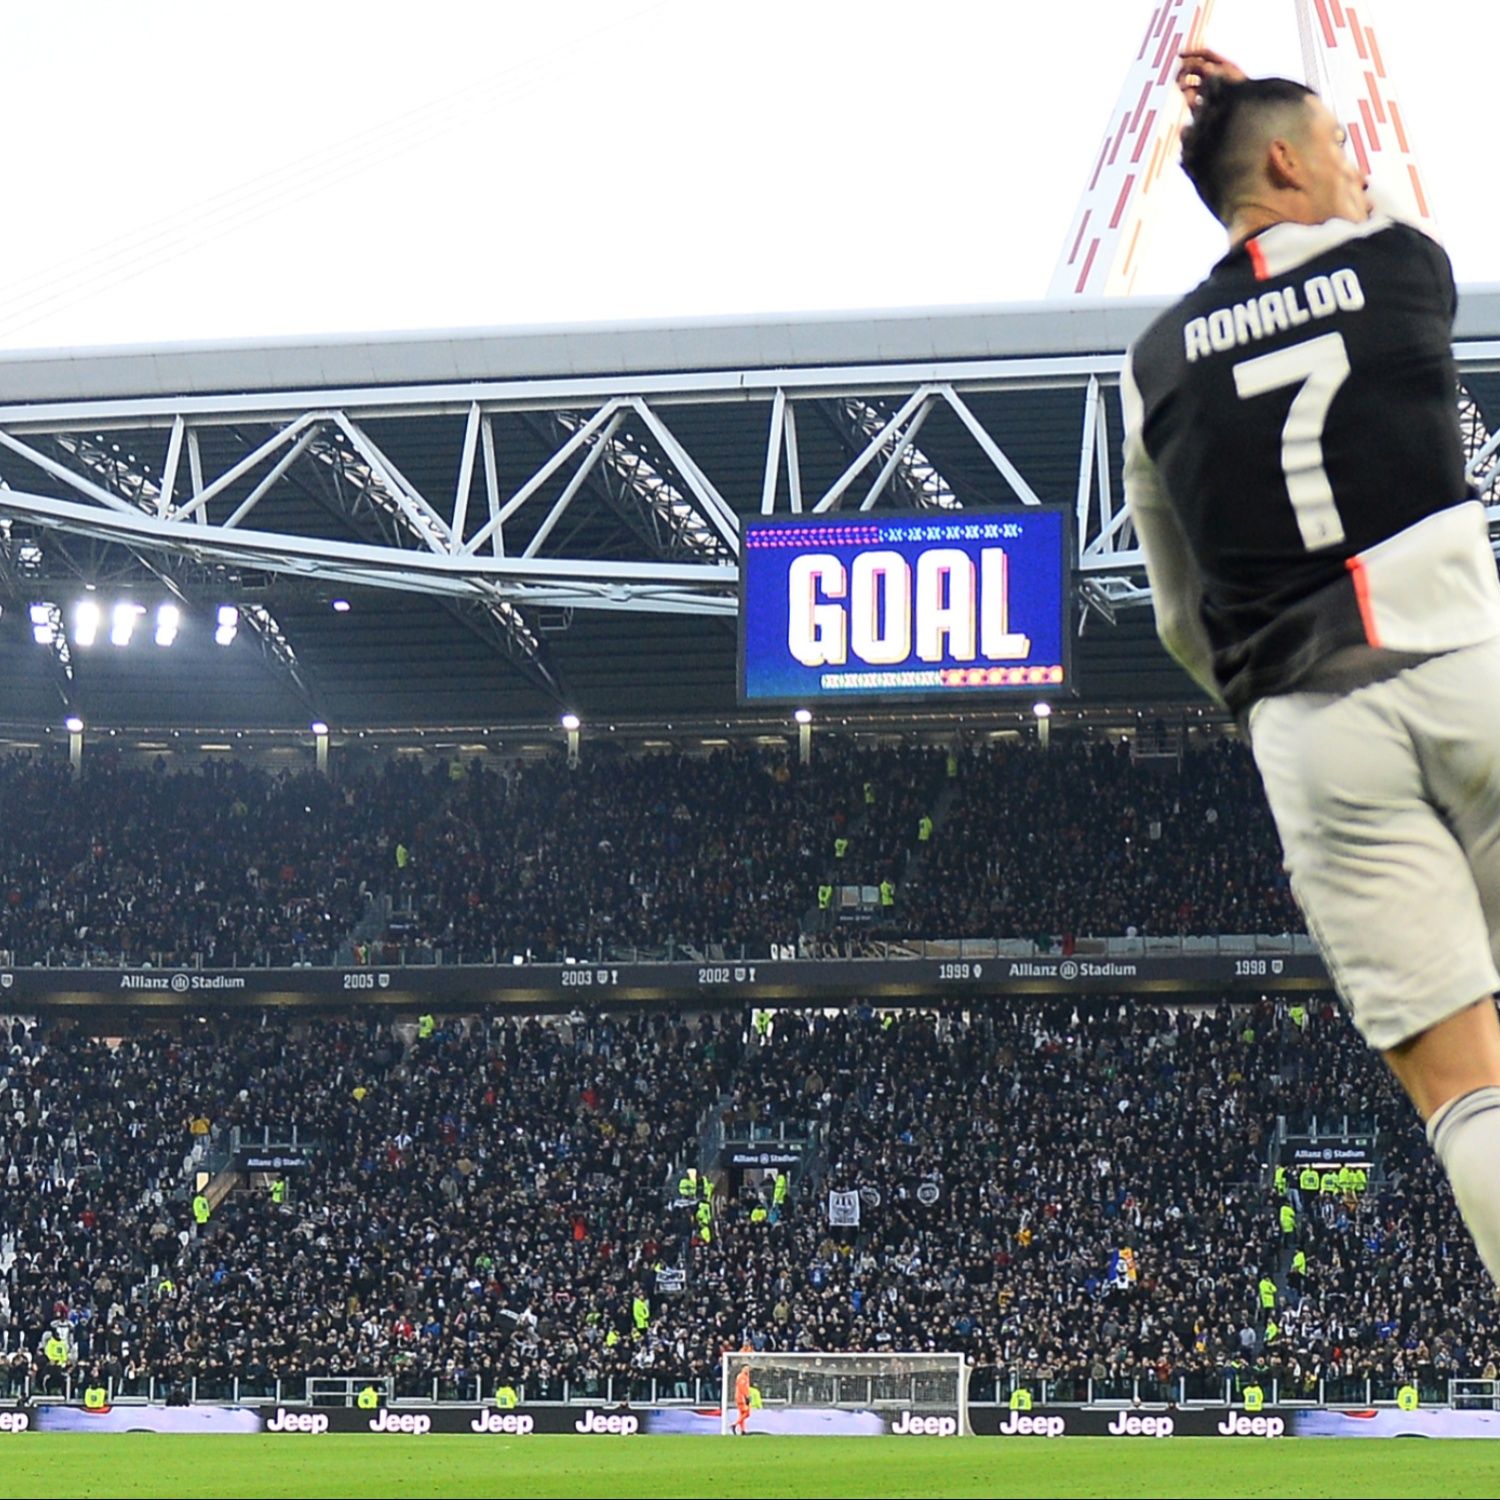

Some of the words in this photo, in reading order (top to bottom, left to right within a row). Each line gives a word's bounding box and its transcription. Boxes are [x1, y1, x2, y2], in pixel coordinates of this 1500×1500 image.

[1184, 268, 1365, 362] RONALDO
[1233, 331, 1351, 552] 7
[788, 548, 1030, 666] GOAL
[562, 971, 592, 986] 2003
[698, 968, 730, 983] 2002
[939, 964, 970, 979] 1999
[1009, 963, 1057, 976] Allianz
[1080, 963, 1136, 976] Stadium
[1234, 960, 1266, 975] 1998
[120, 975, 169, 988] Allianz
[191, 975, 245, 988] Stadium
[344, 974, 374, 989] 2005
[733, 1154, 759, 1162] Allianz
[1295, 1150, 1322, 1158] Allianz
[1334, 1149, 1366, 1158] Stadium
[267, 1408, 328, 1433] Jeep
[369, 1408, 430, 1433] Jeep
[471, 1409, 534, 1434] Jeep
[576, 1409, 638, 1434] Jeep
[892, 1411, 956, 1436] Jeep
[1000, 1411, 1065, 1437] Jeep
[1109, 1411, 1174, 1437] Jeep
[1218, 1411, 1284, 1437] Jeep
